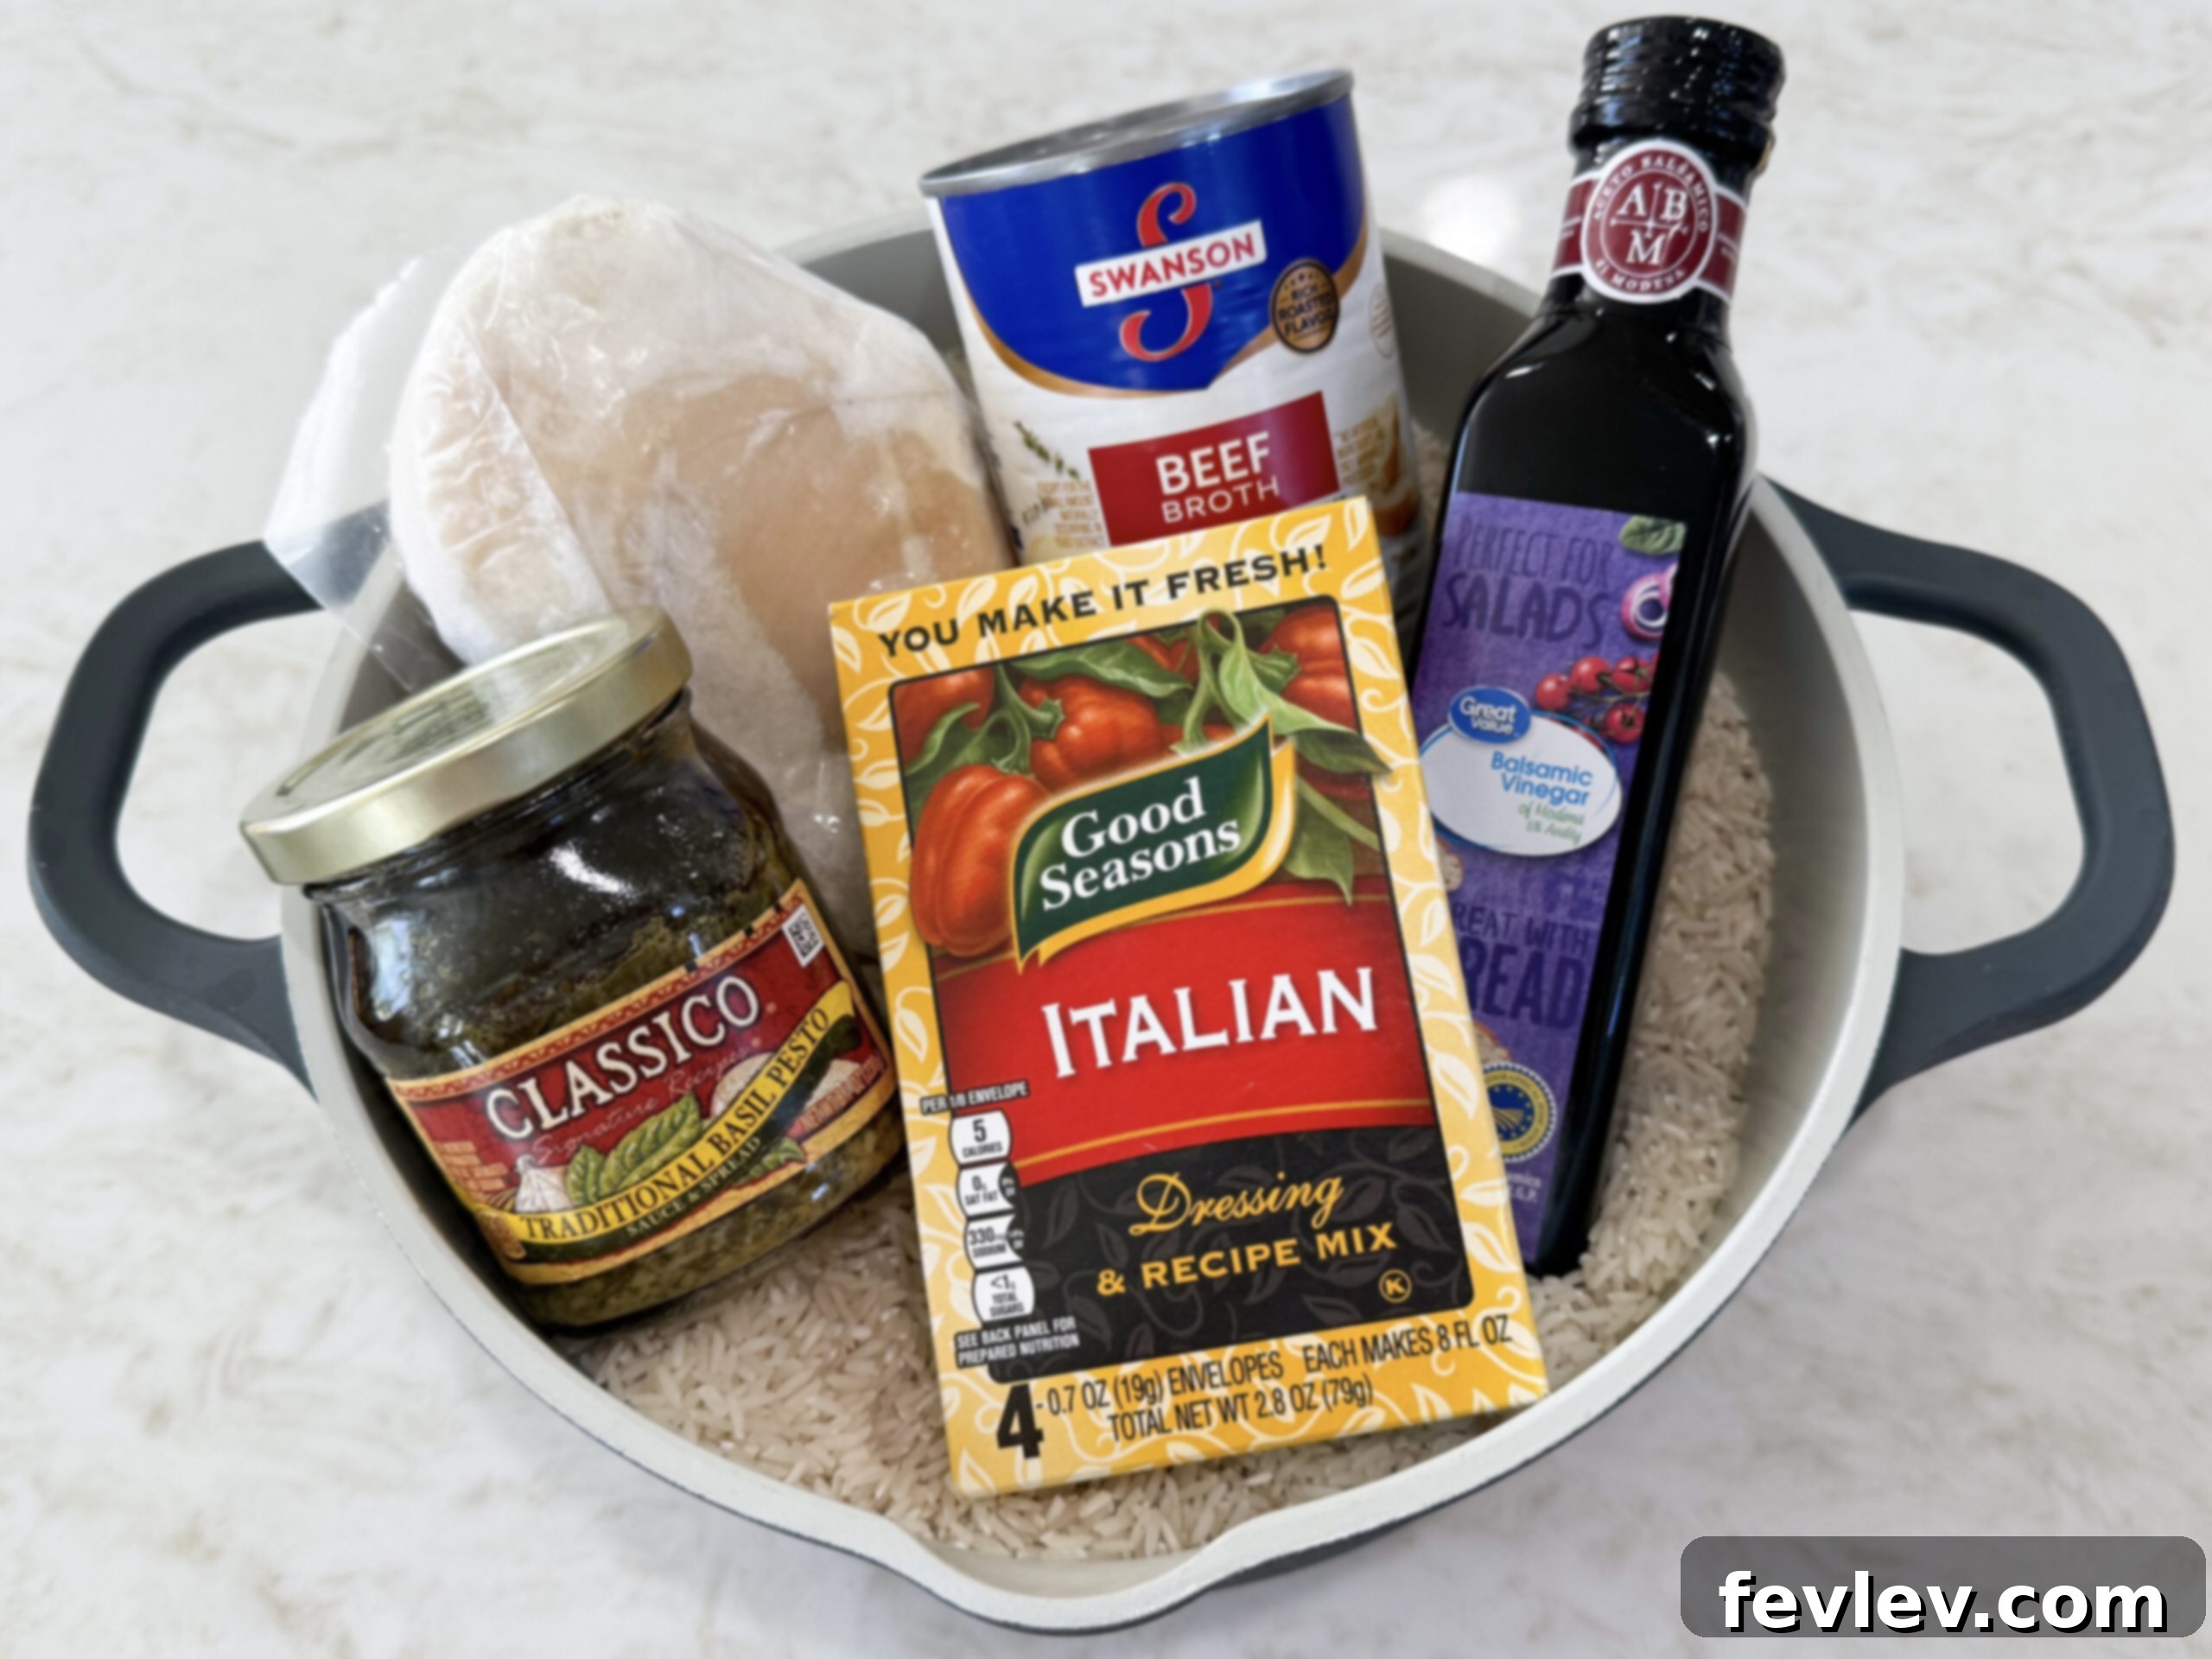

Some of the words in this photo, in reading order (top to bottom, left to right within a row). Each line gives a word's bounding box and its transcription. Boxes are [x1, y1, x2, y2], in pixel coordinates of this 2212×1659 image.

[1089, 233, 1256, 298] SWANSON
[1156, 433, 1270, 495] BEEF
[1161, 475, 1281, 525] BROTH
[1453, 518, 1555, 577] PERFECT
[1560, 536, 1617, 586] FOR
[879, 618, 961, 659] YOU
[977, 590, 1096, 640] MAKE
[1111, 579, 1149, 612] IT
[1167, 543, 1328, 601] FRESH!
[1442, 571, 1611, 651] SALADS
[1459, 696, 1518, 724] Great
[1491, 750, 1593, 787] Balsamic
[1501, 772, 1590, 807] Vinegar
[1061, 775, 1207, 860] Good
[1039, 817, 1242, 912] Seasons
[1452, 901, 1518, 938] REAT
[1525, 916, 1595, 957] WITH
[1459, 935, 1586, 1032] READ
[1041, 967, 1379, 1078] ITALIAN
[485, 974, 760, 1141] CLASSICO
[521, 1149, 715, 1240] TRADITIONAL
[707, 1085, 776, 1158] BASIL
[766, 1007, 830, 1088] PESTO
[921, 1095, 948, 1114] PER
[968, 1080, 1028, 1106] ENVELOPE
[531, 1096, 660, 1166] Signature
[962, 1141, 1003, 1158] CALORIES
[972, 1118, 987, 1143] 5
[625, 1197, 687, 1238] SAUCE
[701, 1135, 762, 1192] SPREAD
[964, 1194, 981, 1206] SAT
[982, 1190, 998, 1203] FAT
[1129, 1172, 1344, 1237] Dressing
[1097, 1269, 1125, 1297] &
[1141, 1240, 1301, 1291] RECIPE
[1317, 1221, 1398, 1260] MIX
[989, 1302, 1025, 1318] SUGARS
[991, 1291, 1018, 1306] TOTAL
[957, 1332, 978, 1350] SEE
[982, 1326, 1011, 1345] BACK
[1014, 1320, 1050, 1339] PANEL
[1052, 1315, 1077, 1333] FOR
[958, 1343, 1017, 1365] PREPARED
[1020, 1332, 1080, 1356] NUTRITION
[996, 1383, 1044, 1459] 4
[1081, 1379, 1111, 1411] OZ
[1113, 1370, 1165, 1410] (19g)
[1168, 1351, 1285, 1396] ENVELOPES
[1302, 1338, 1358, 1373] EACH
[1361, 1325, 1433, 1363] MAKES
[1436, 1323, 1452, 1345] 8
[1452, 1319, 1480, 1350] FL
[1482, 1313, 1512, 1345] OZ
[1108, 1406, 1172, 1443] TOTAL
[1174, 1400, 1213, 1433] NET
[1215, 1393, 1250, 1424] WT
[1255, 1386, 1287, 1419] 2.8
[1289, 1381, 1322, 1413] OZ
[1321, 1372, 1373, 1412] (79g)
